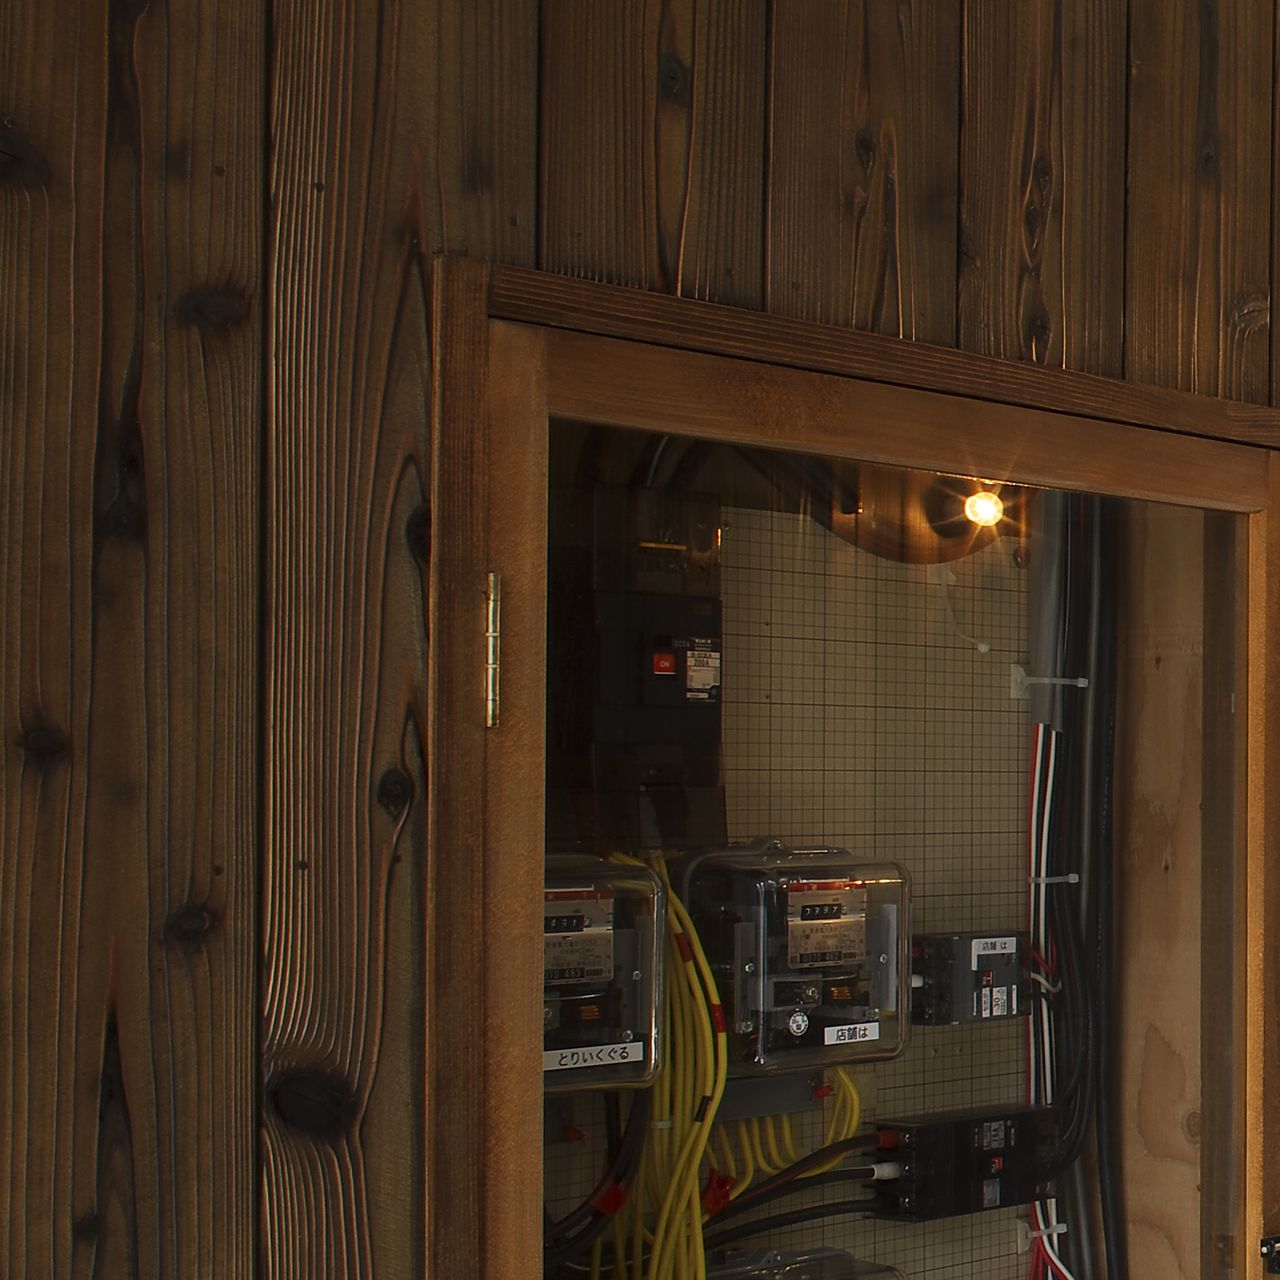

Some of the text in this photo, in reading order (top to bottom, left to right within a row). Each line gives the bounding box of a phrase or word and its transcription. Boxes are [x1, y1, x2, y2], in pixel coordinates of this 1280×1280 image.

[836, 1026, 869, 1042] 店舗は
[558, 1046, 630, 1067] とりいくぐる
